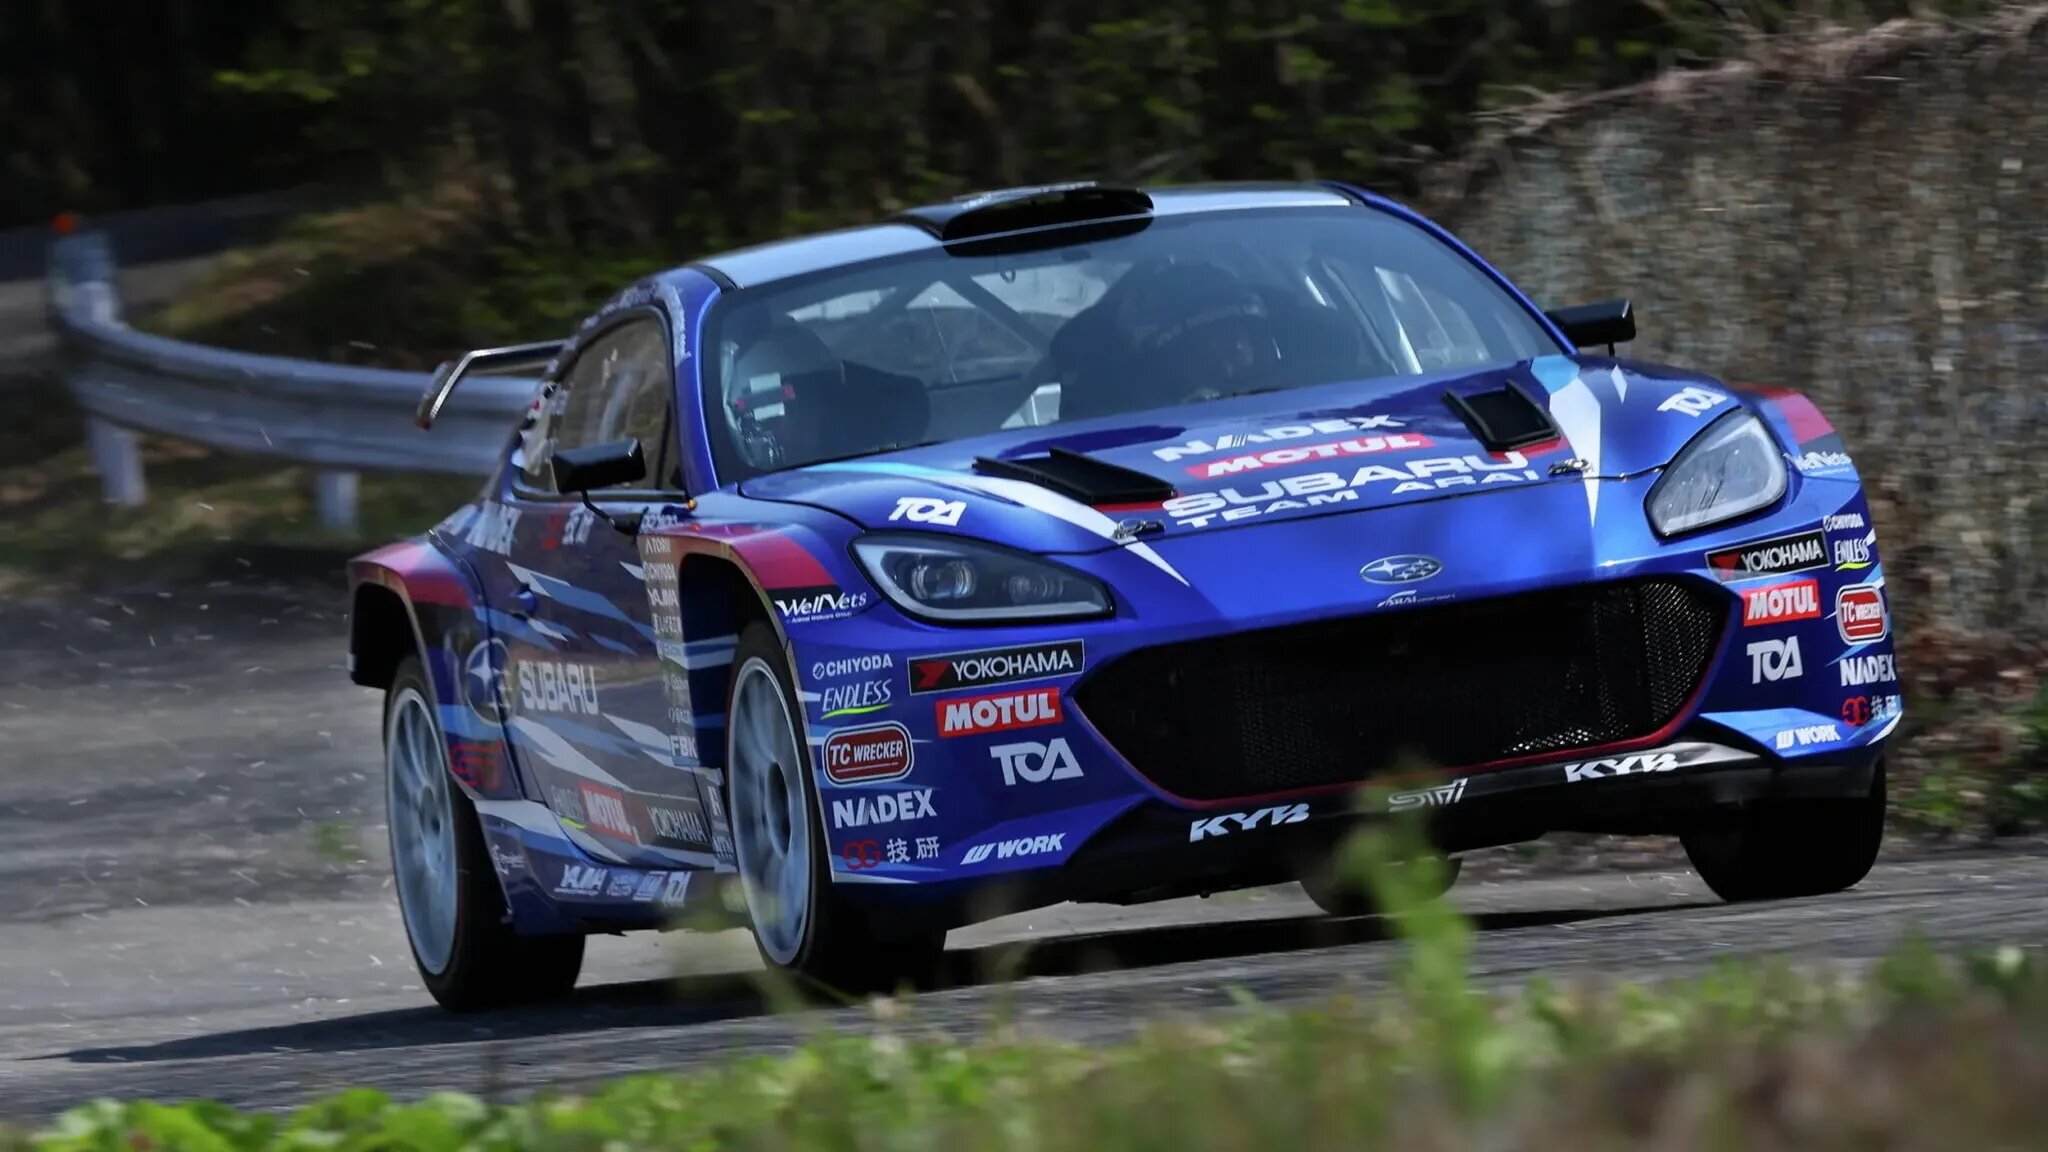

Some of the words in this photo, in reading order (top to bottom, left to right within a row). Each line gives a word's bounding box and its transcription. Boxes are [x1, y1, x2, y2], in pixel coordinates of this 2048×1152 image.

[1657, 387, 1728, 418] TOA
[1153, 415, 1406, 462] NADEX
[1208, 435, 1421, 477] MOTUL
[1162, 451, 1529, 518] SUBARU
[1177, 490, 1359, 529] TEAM
[1392, 469, 1539, 495] ARAI
[887, 496, 967, 527] TOA
[1741, 538, 1824, 573] YOKOHAMA
[774, 592, 867, 617] WellVets
[1747, 584, 1819, 620] MOTUL
[1841, 601, 1857, 623] TC
[826, 654, 893, 676] CHIYODA
[952, 649, 1074, 681] YOKOHAMA
[1746, 635, 1803, 684] TOA
[1840, 654, 1897, 686] NADEX
[517, 659, 599, 716] SUBARU
[822, 679, 892, 712] ENDLESS
[944, 692, 1056, 732] MOTUL
[1795, 724, 1841, 746] WORK
[829, 742, 851, 766] TC
[853, 739, 904, 763] WRECKER
[990, 737, 1085, 786] TOA
[1565, 753, 1679, 783] KYB
[646, 805, 710, 845] YOKOHAMA
[832, 788, 937, 829] NADEX
[1189, 802, 1310, 843] KYB
[886, 836, 941, 864] 技研
[996, 833, 1067, 860] WORK
